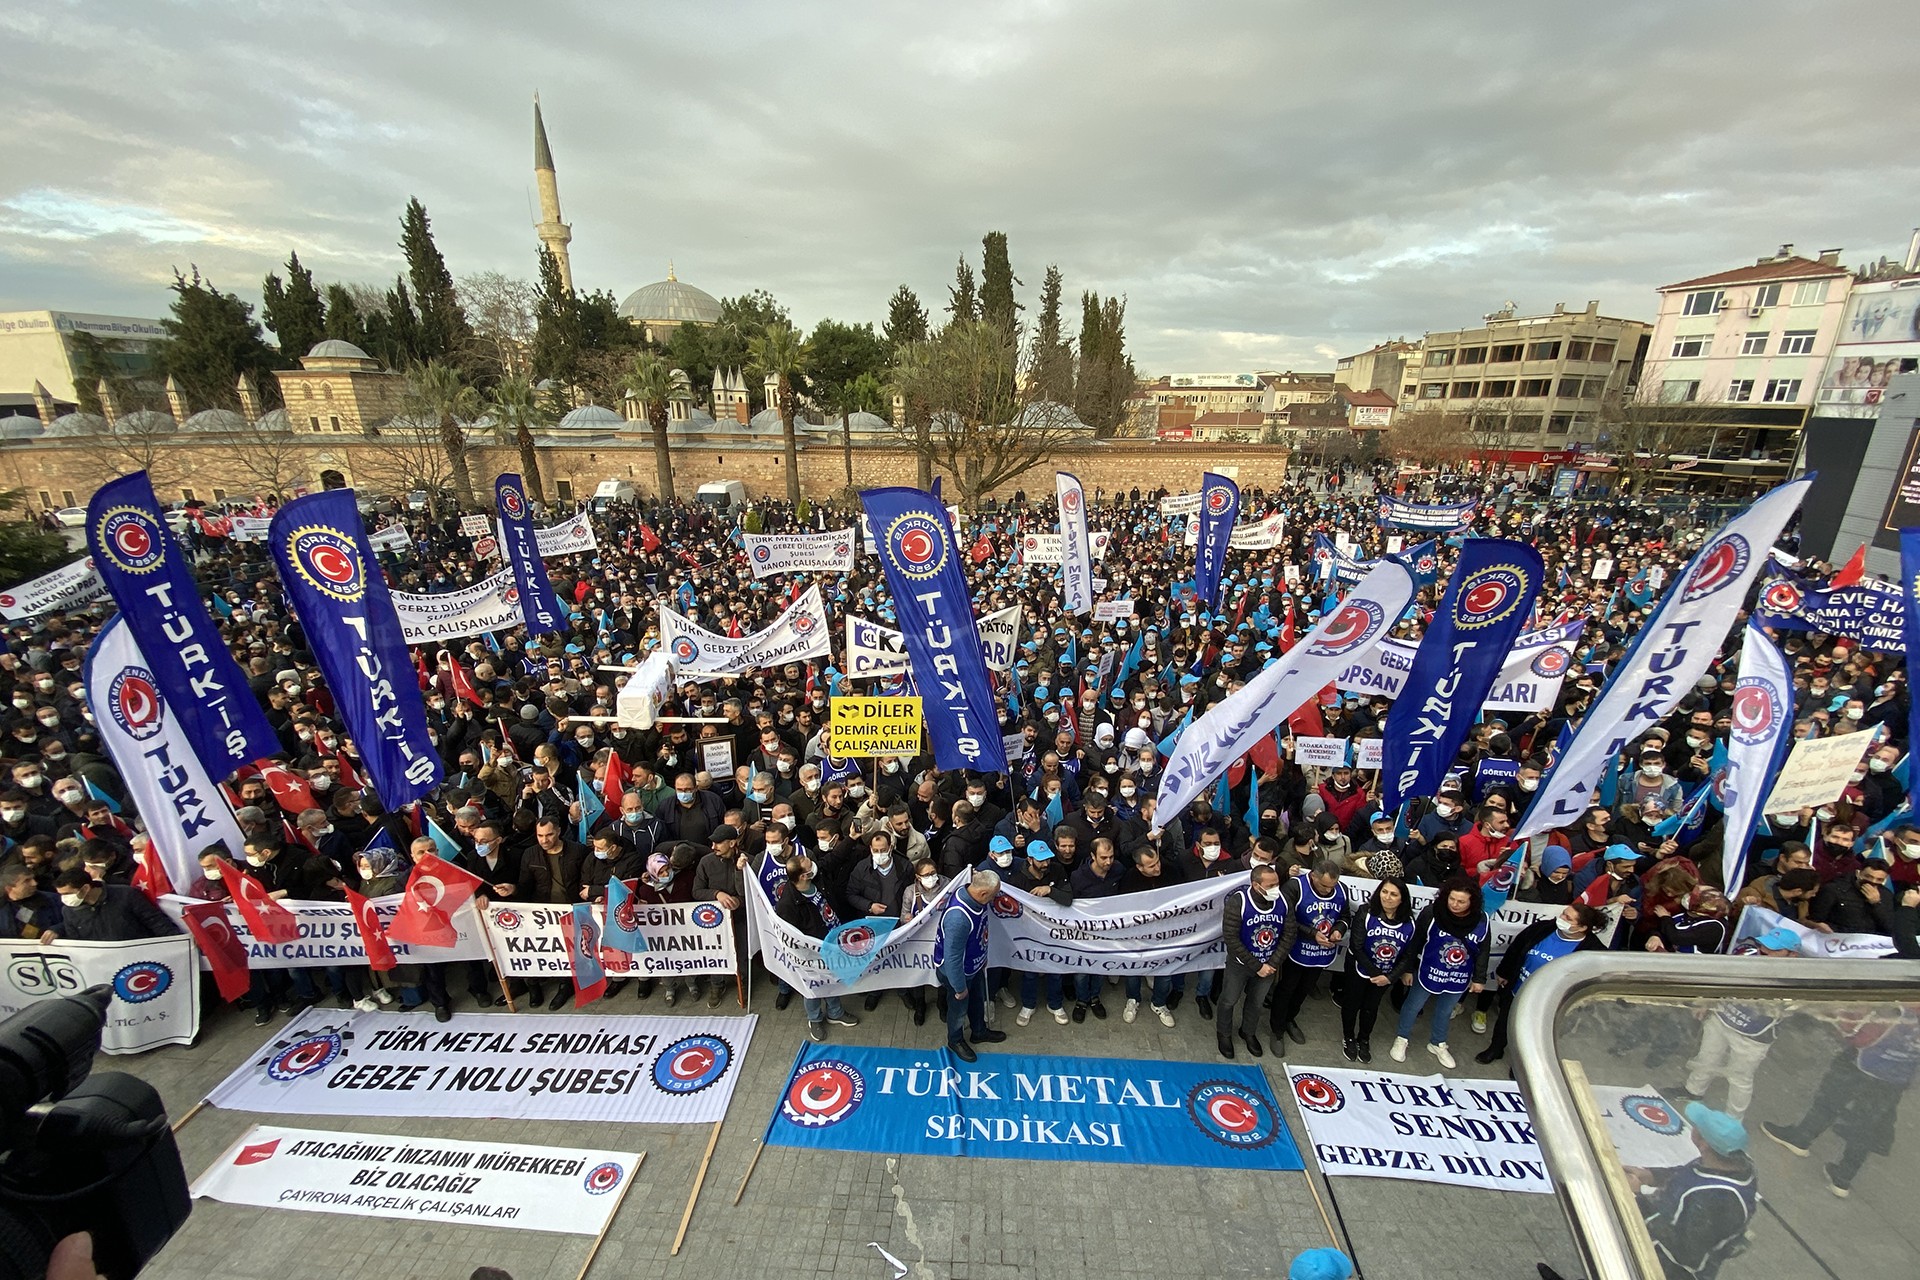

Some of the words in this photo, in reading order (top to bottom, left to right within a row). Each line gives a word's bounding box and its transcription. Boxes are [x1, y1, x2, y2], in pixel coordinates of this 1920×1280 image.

[74, 320, 111, 331] Marmara
[112, 323, 131, 334] Bilge
[550, 540, 591, 553] ÇALIŞANLARI
[750, 536, 774, 544] TÜRK
[797, 542, 831, 550] DİLOVASI
[128, 552, 158, 567] 1952
[761, 559, 792, 572] HANON
[793, 559, 846, 568] ÇALIŞANLARI
[22, 585, 76, 614] KALKANCI
[77, 575, 98, 592] PRES
[30, 583, 58, 599] NOLU
[325, 581, 361, 594] 1952
[397, 603, 439, 613] GEBZE
[1816, 608, 1850, 617] AMA
[427, 610, 518, 637] ÇALIŞANLARI
[703, 643, 738, 654] GEBZE
[1622, 620, 1700, 722] TÜRK
[864, 700, 914, 718] DİLER
[834, 723, 878, 736] DEMİR
[882, 722, 917, 738] ÇELİK
[834, 740, 918, 753] ÇALIŞANLARI
[1482, 768, 1516, 777] GÖREVLİ
[144, 740, 216, 840] TÜRK
[1074, 918, 1130, 932] METAL
[1132, 899, 1214, 926] SENDİKASI
[1306, 902, 1342, 914] GÖREVLİ
[1246, 914, 1284, 927] GÖREVLİ
[511, 958, 532, 971] HP
[644, 956, 728, 973] Çalışanları
[1012, 948, 1098, 968] AUTOLİV
[1430, 967, 1449, 978] TÜRK
[115, 1017, 140, 1028] TİC.
[143, 1014, 156, 1023] A.
[159, 1011, 170, 1021] Ş.
[365, 1025, 438, 1051] TÜRK
[432, 1031, 517, 1053] METAL
[520, 1028, 658, 1056] SENDİKASI
[276, 1046, 298, 1062] TÜRK
[327, 1064, 430, 1090] GEBZE
[426, 1066, 450, 1091] 1
[445, 1066, 533, 1093] NOLU
[529, 1062, 644, 1097] ŞUBESİ
[666, 1078, 704, 1090] 1952
[799, 1061, 834, 1076] METAL
[835, 1063, 864, 1102] SENDİKASI
[876, 1061, 1002, 1100] TÜRK
[1013, 1072, 1181, 1109] METAL
[1351, 1077, 1467, 1110] TÜRK
[925, 1113, 1125, 1148] SENDİKASI
[1219, 1131, 1262, 1143] 1952
[285, 1140, 396, 1163] ATACAĞINIZ
[392, 1143, 475, 1169] İMZANIN
[473, 1151, 587, 1177] MÜREKKEBİ
[1315, 1143, 1434, 1172] GEBZE
[1439, 1151, 1545, 1181] DİLOV
[349, 1165, 388, 1188] BİZ
[385, 1171, 482, 1195] OLACAĞIZ
[278, 1188, 351, 1206] ÇAYIROVA
[350, 1195, 420, 1211] ARÇELİK
[418, 1200, 521, 1220] ÇALIŞANLARI
